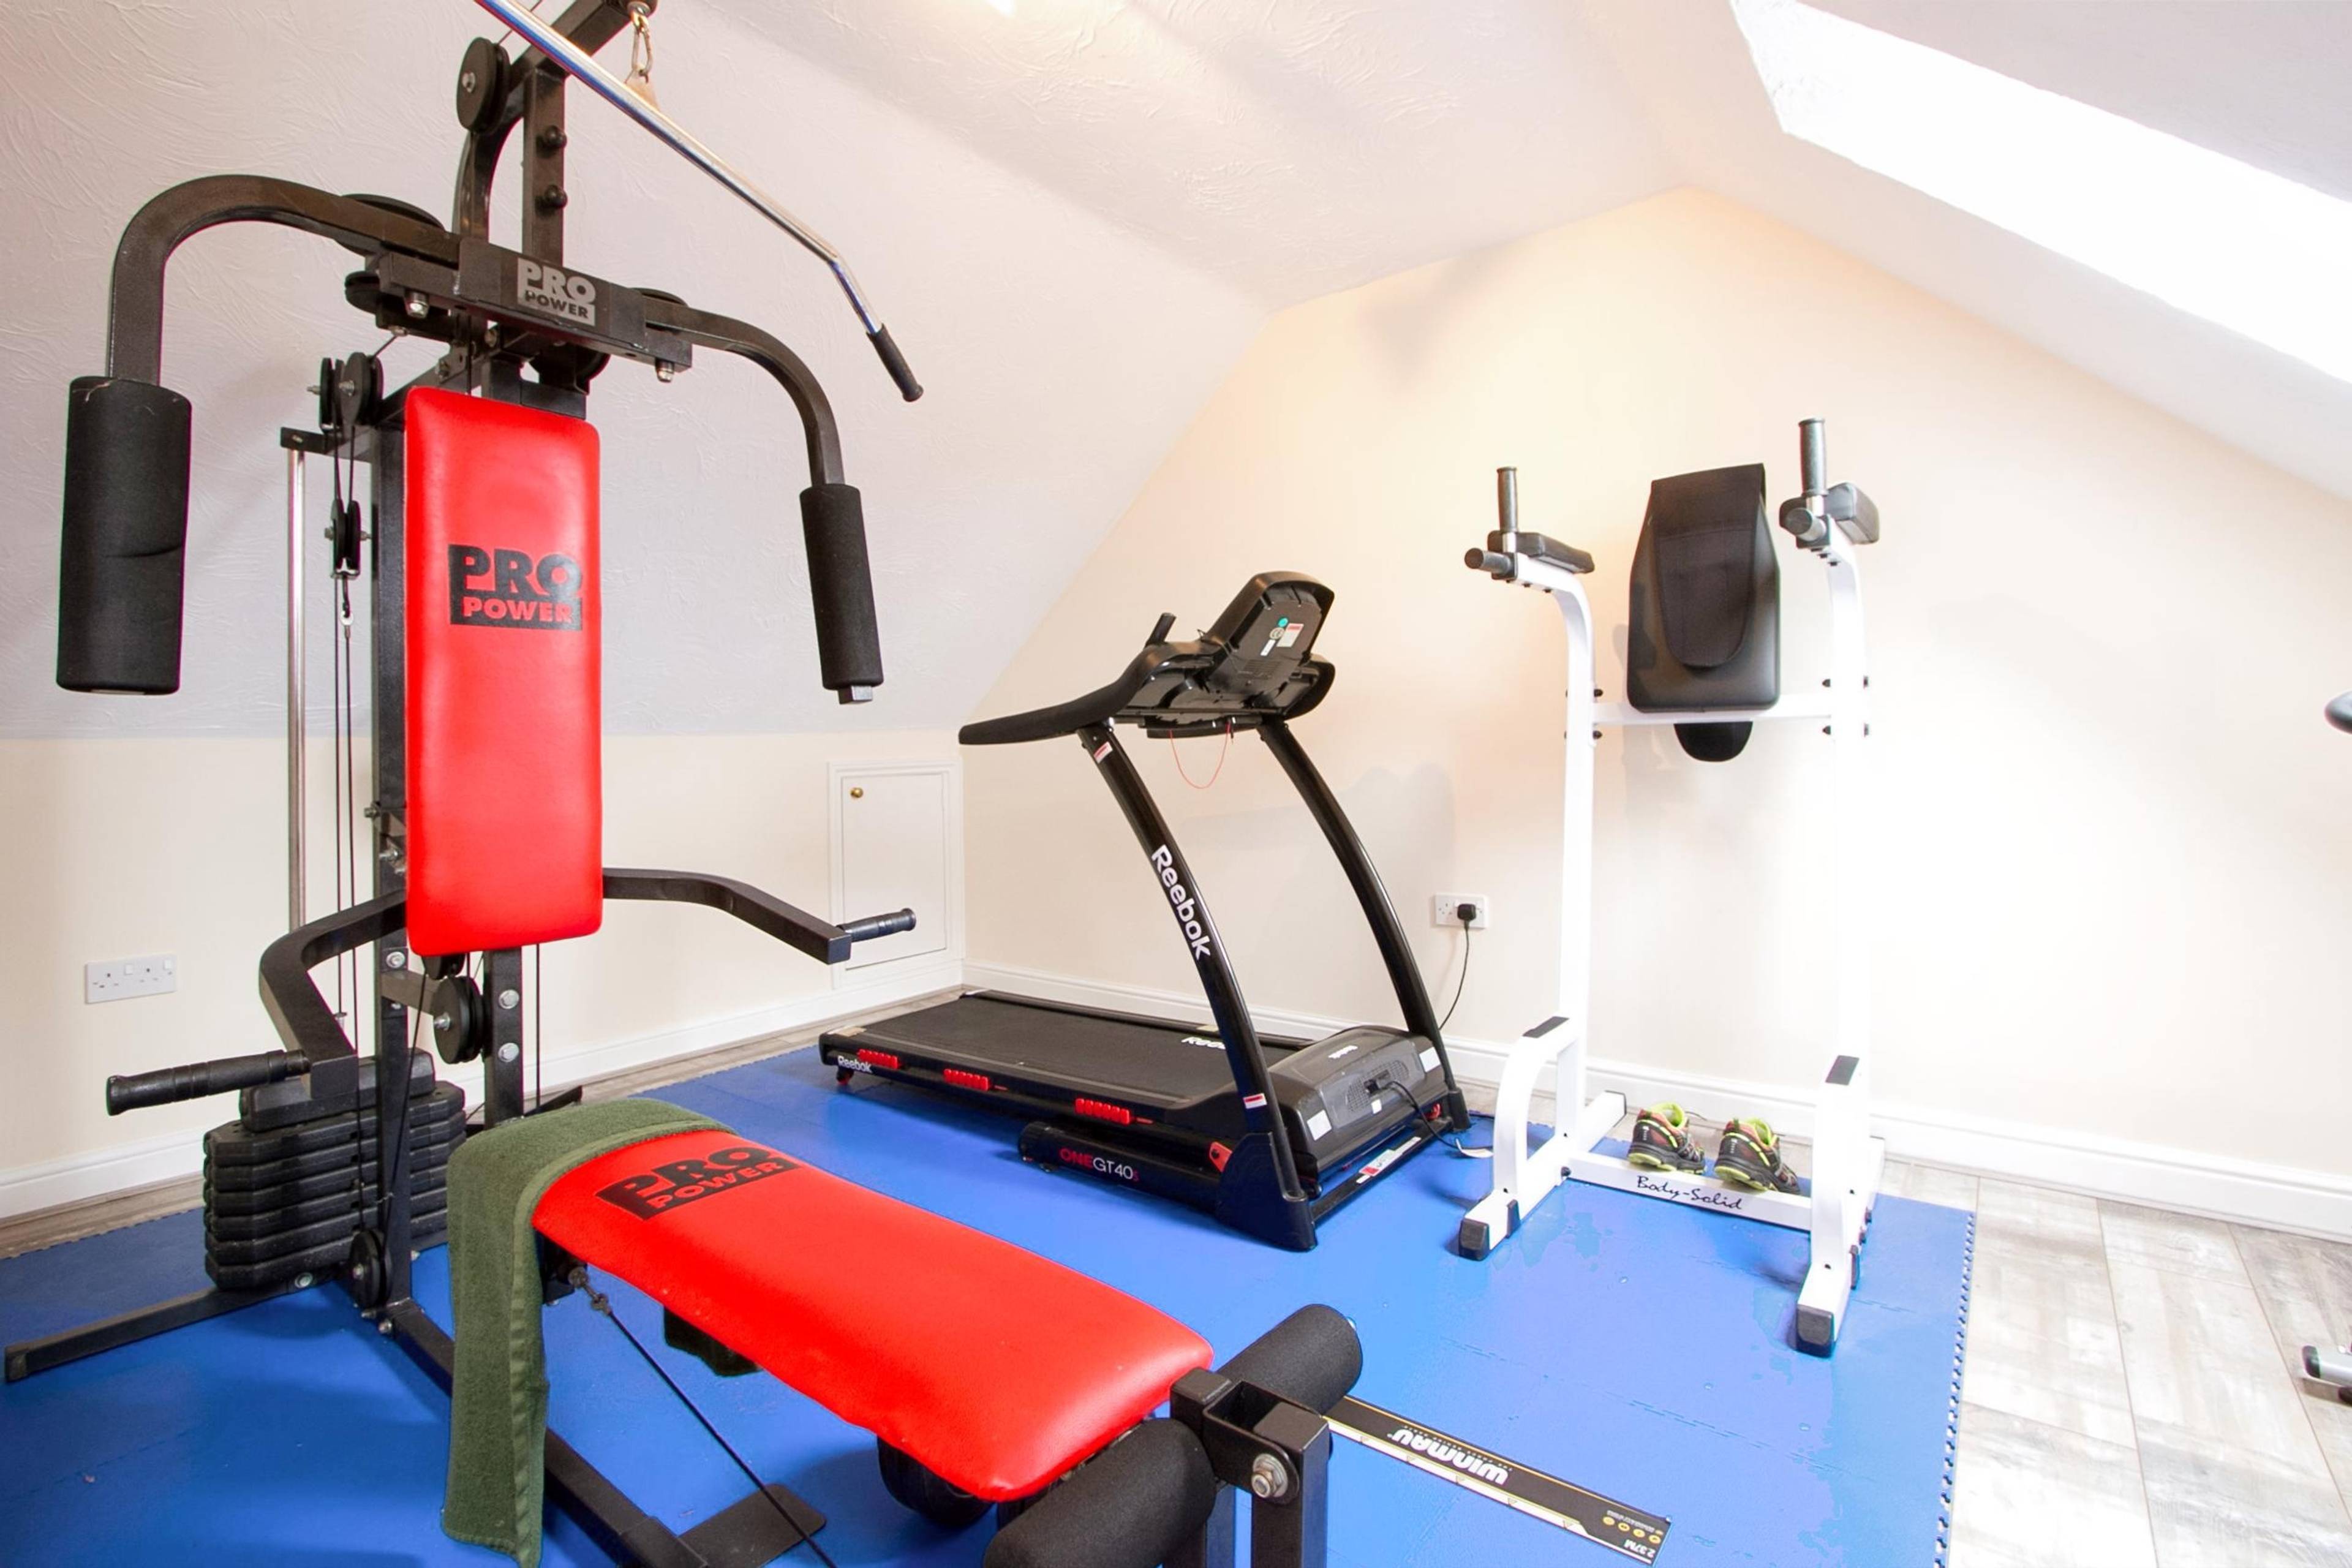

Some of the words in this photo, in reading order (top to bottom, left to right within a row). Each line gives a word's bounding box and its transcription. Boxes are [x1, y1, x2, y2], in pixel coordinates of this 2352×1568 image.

[518, 257, 596, 304] PRO
[525, 290, 589, 319] POWER
[448, 544, 582, 599] PRO
[462, 596, 573, 624] POWER
[1151, 844, 1211, 961] Reebok
[837, 1055, 873, 1074] Reebok
[595, 1147, 774, 1220] PRO
[646, 1161, 785, 1209] POWER
[1637, 1175, 1742, 1210] Body-Solid
